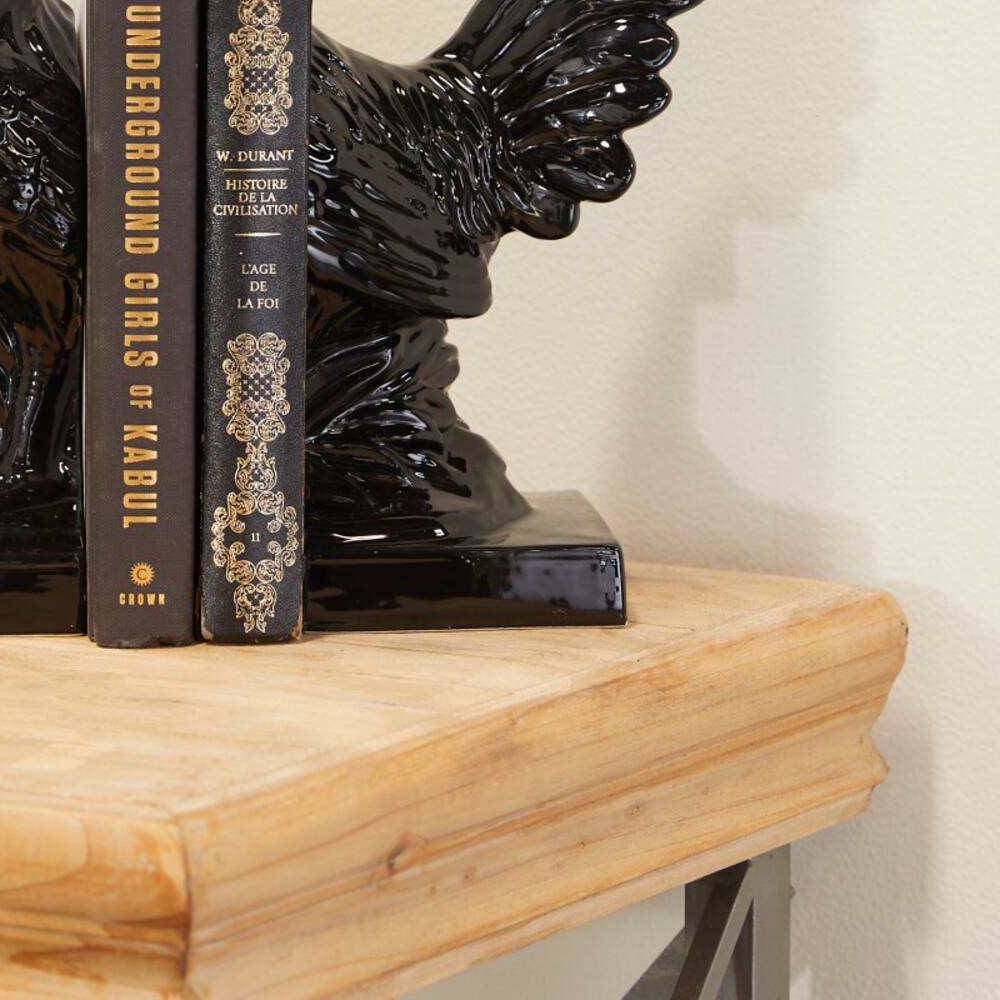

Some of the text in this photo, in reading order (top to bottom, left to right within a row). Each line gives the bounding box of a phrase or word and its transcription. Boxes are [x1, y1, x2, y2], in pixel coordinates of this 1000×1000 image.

[124, 5, 161, 255] UNDERGROUND
[215, 149, 295, 162] W. DURANT
[225, 178, 288, 191] HISTOIRE
[238, 191, 277, 203] DE LA
[212, 203, 298, 216] CIVILISATION
[249, 280, 268, 292] DE
[237, 297, 279, 310] LA FOI
[123, 272, 160, 367] GIRLS
[129, 384, 153, 409] OF
[122, 424, 158, 529] KABUL
[119, 592, 166, 606] CROWN
